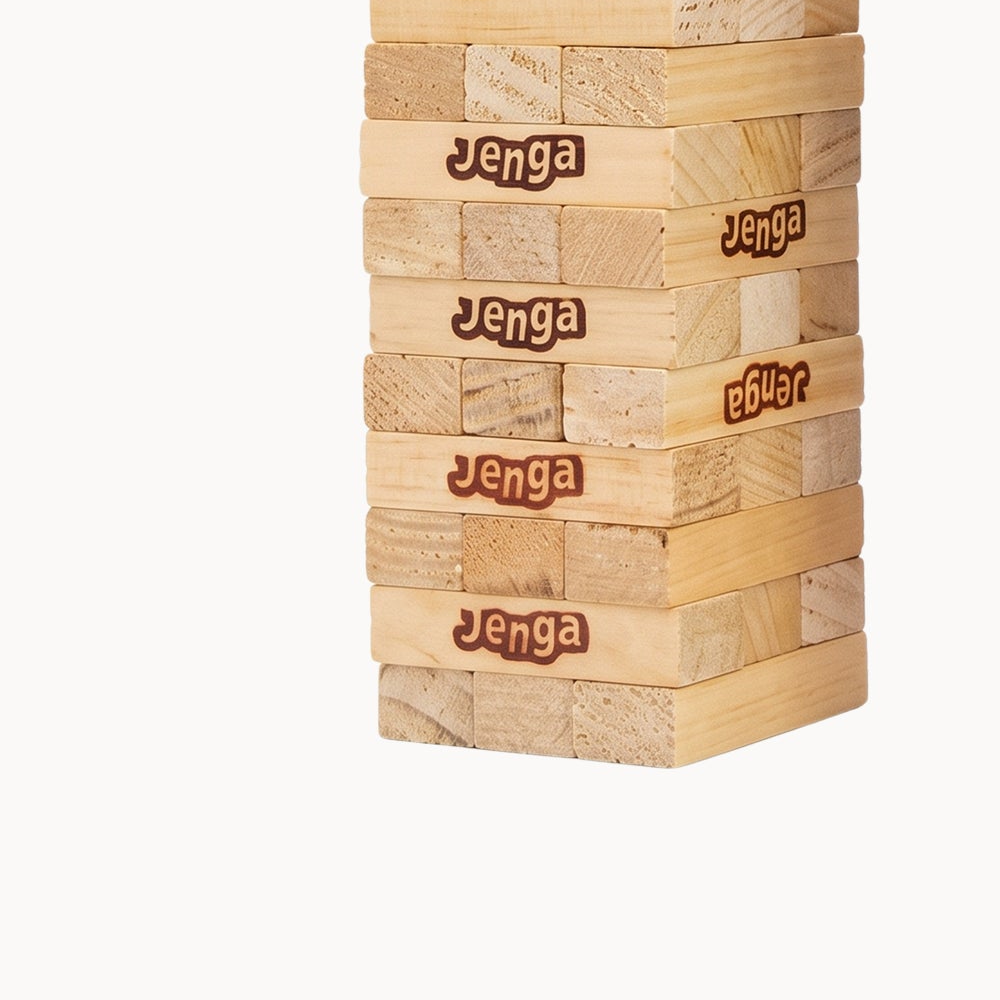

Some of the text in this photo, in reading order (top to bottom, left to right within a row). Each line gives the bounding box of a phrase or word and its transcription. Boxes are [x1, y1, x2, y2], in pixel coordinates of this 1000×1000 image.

[449, 136, 582, 187] Jenga
[723, 202, 803, 256] Jenga
[454, 297, 583, 349] Jenga
[726, 363, 808, 422] Jenga
[451, 455, 581, 506] Jenga
[456, 610, 586, 661] Jenga
